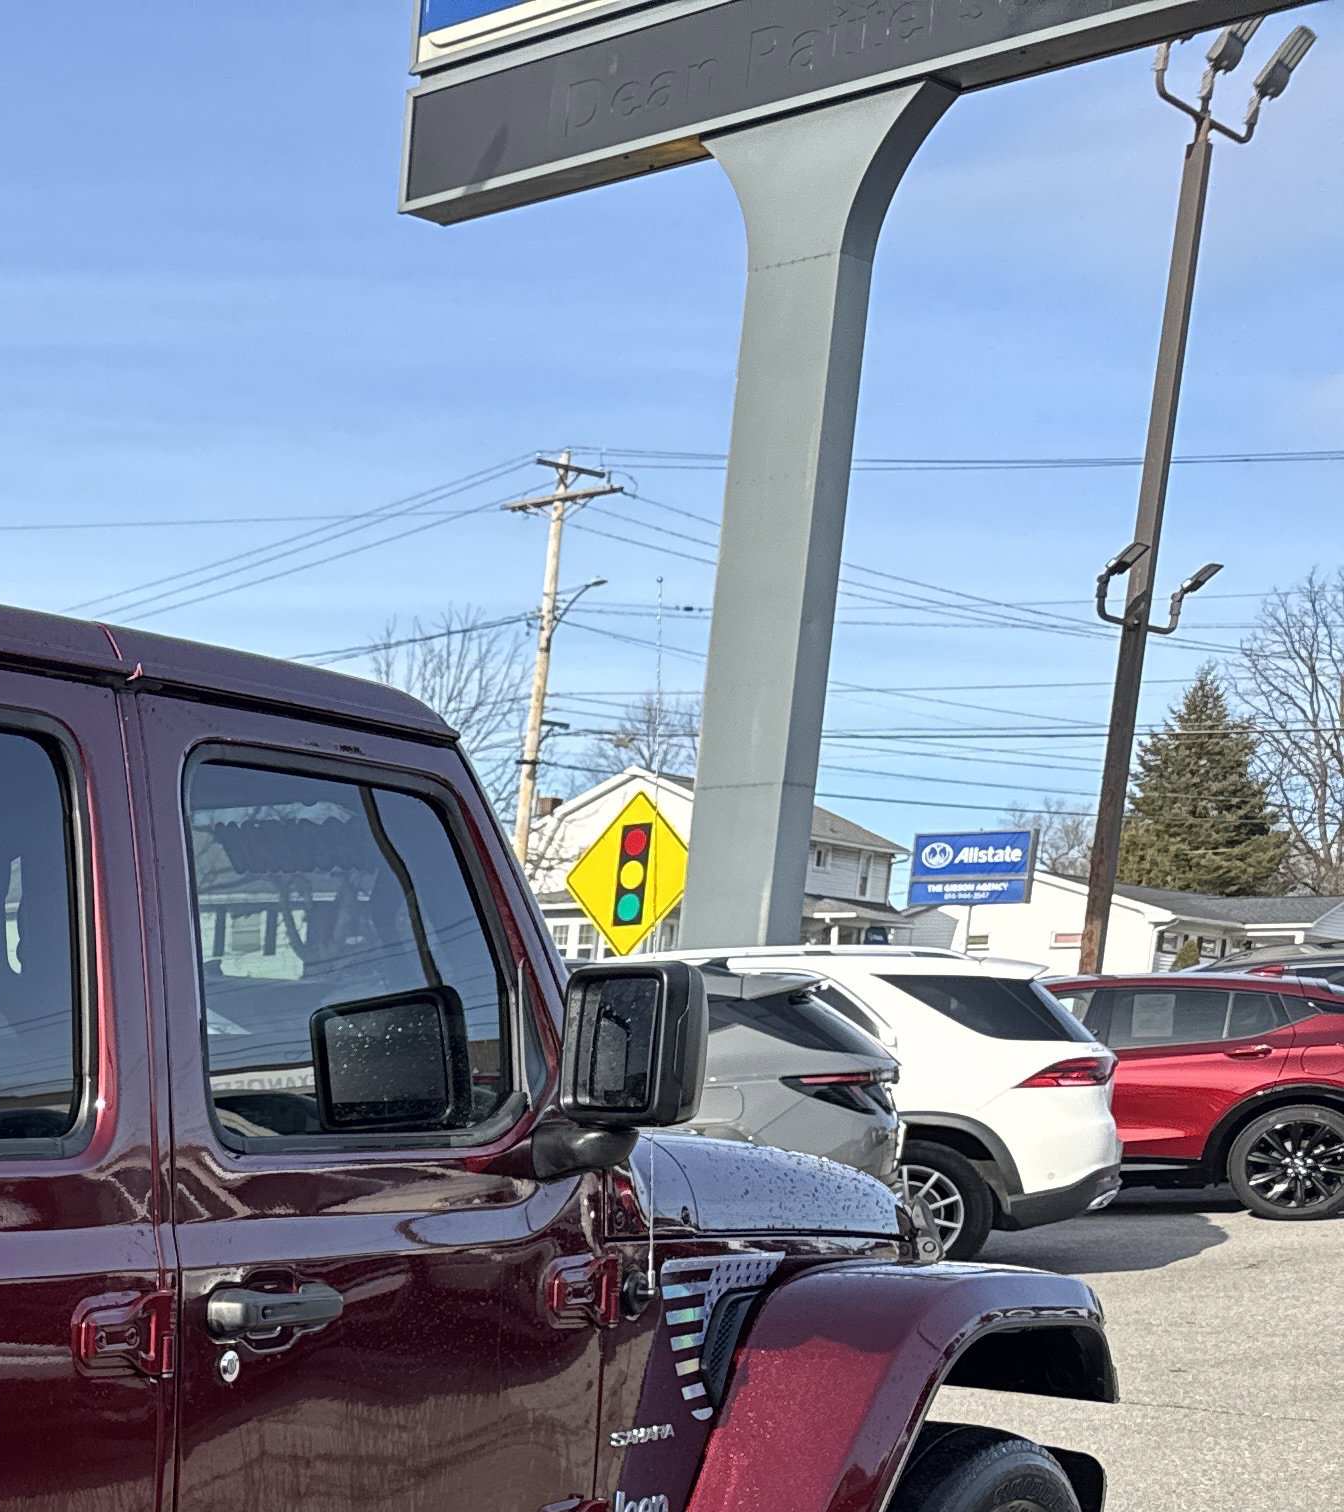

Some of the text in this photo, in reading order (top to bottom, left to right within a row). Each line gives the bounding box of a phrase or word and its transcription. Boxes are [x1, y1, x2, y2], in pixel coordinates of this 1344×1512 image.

[563, 58, 720, 139] Dean
[953, 845, 1023, 864] Allstate
[975, 882, 1008, 891] AGENCY
[610, 1423, 675, 1447] SAHARA
